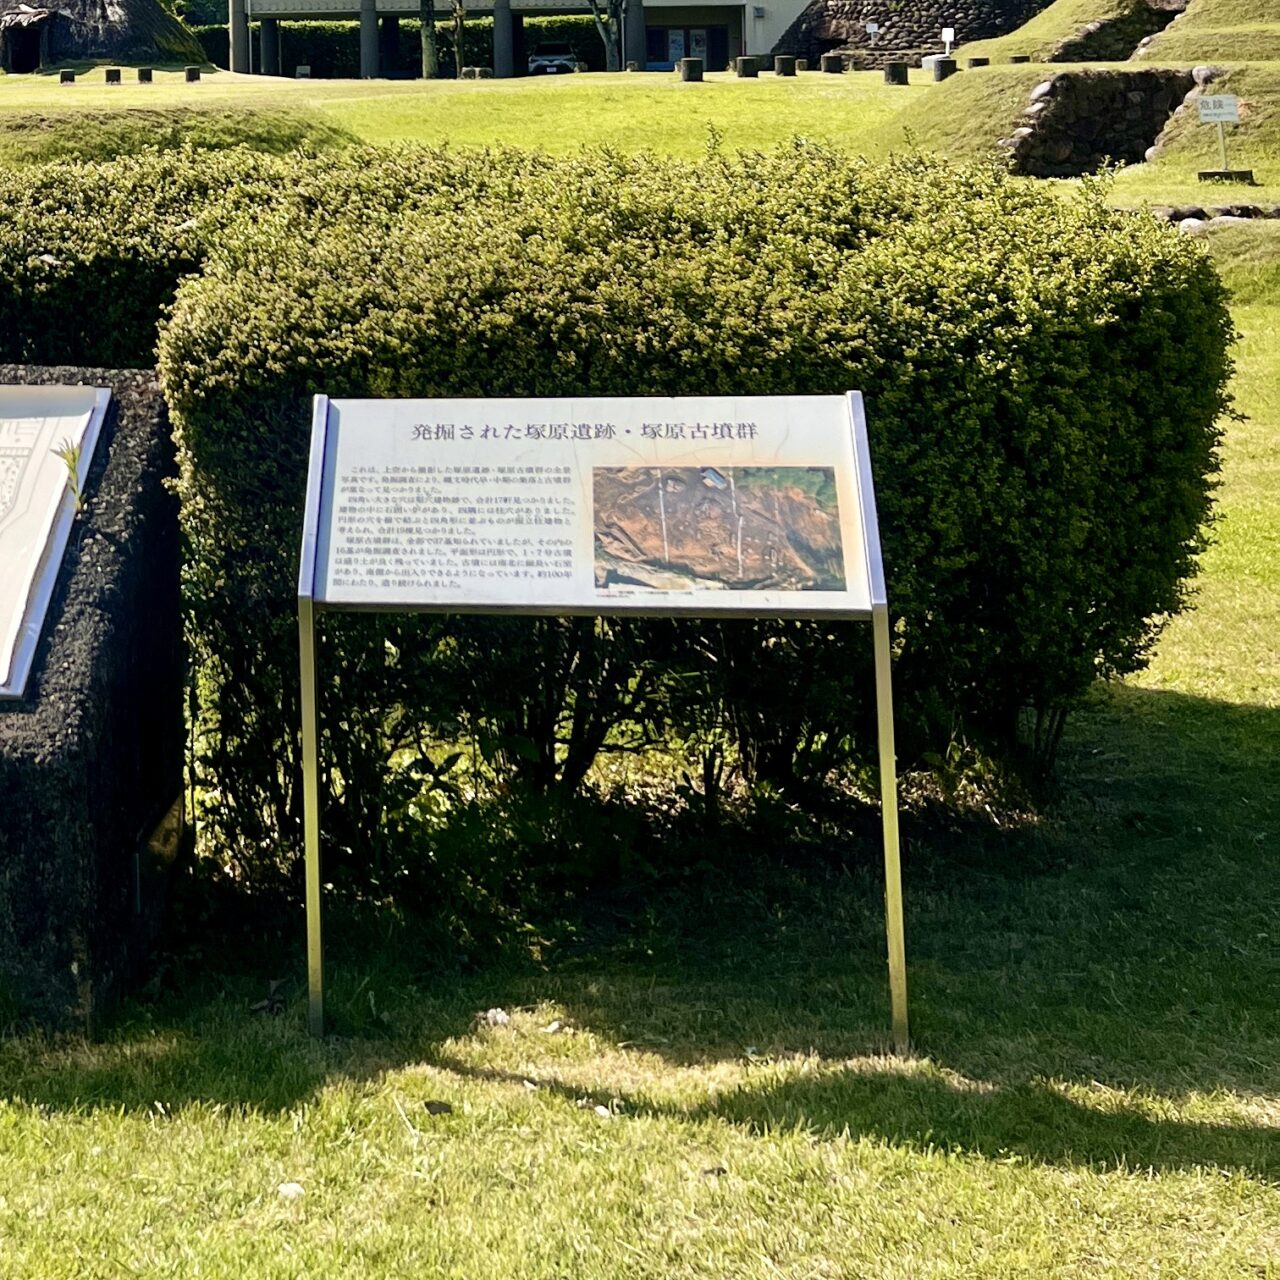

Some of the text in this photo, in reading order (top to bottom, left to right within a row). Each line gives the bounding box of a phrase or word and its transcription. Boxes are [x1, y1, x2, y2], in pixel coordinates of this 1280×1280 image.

[411, 422, 759, 441] 発掘された塚原遺跡・塚原古墳群
